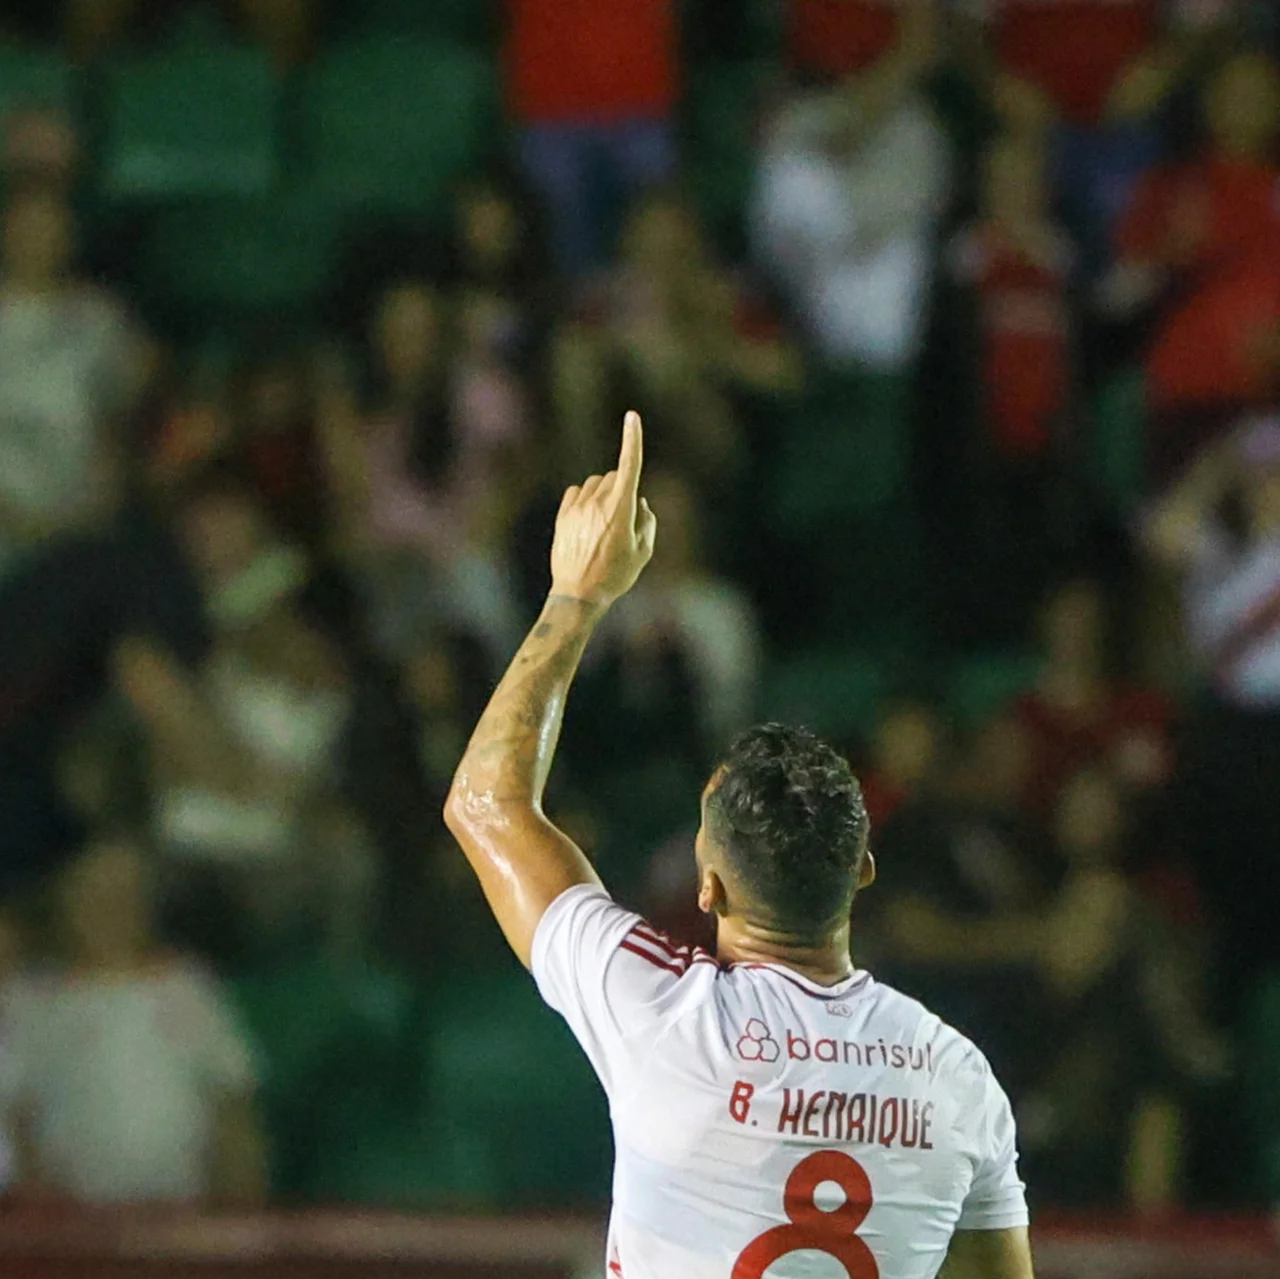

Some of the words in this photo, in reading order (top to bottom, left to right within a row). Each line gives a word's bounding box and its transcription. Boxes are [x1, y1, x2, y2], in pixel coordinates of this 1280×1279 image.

[786, 1029, 933, 1072] banrisul
[728, 1080, 758, 1127] B.
[777, 1087, 934, 1149] HENRIQUE
